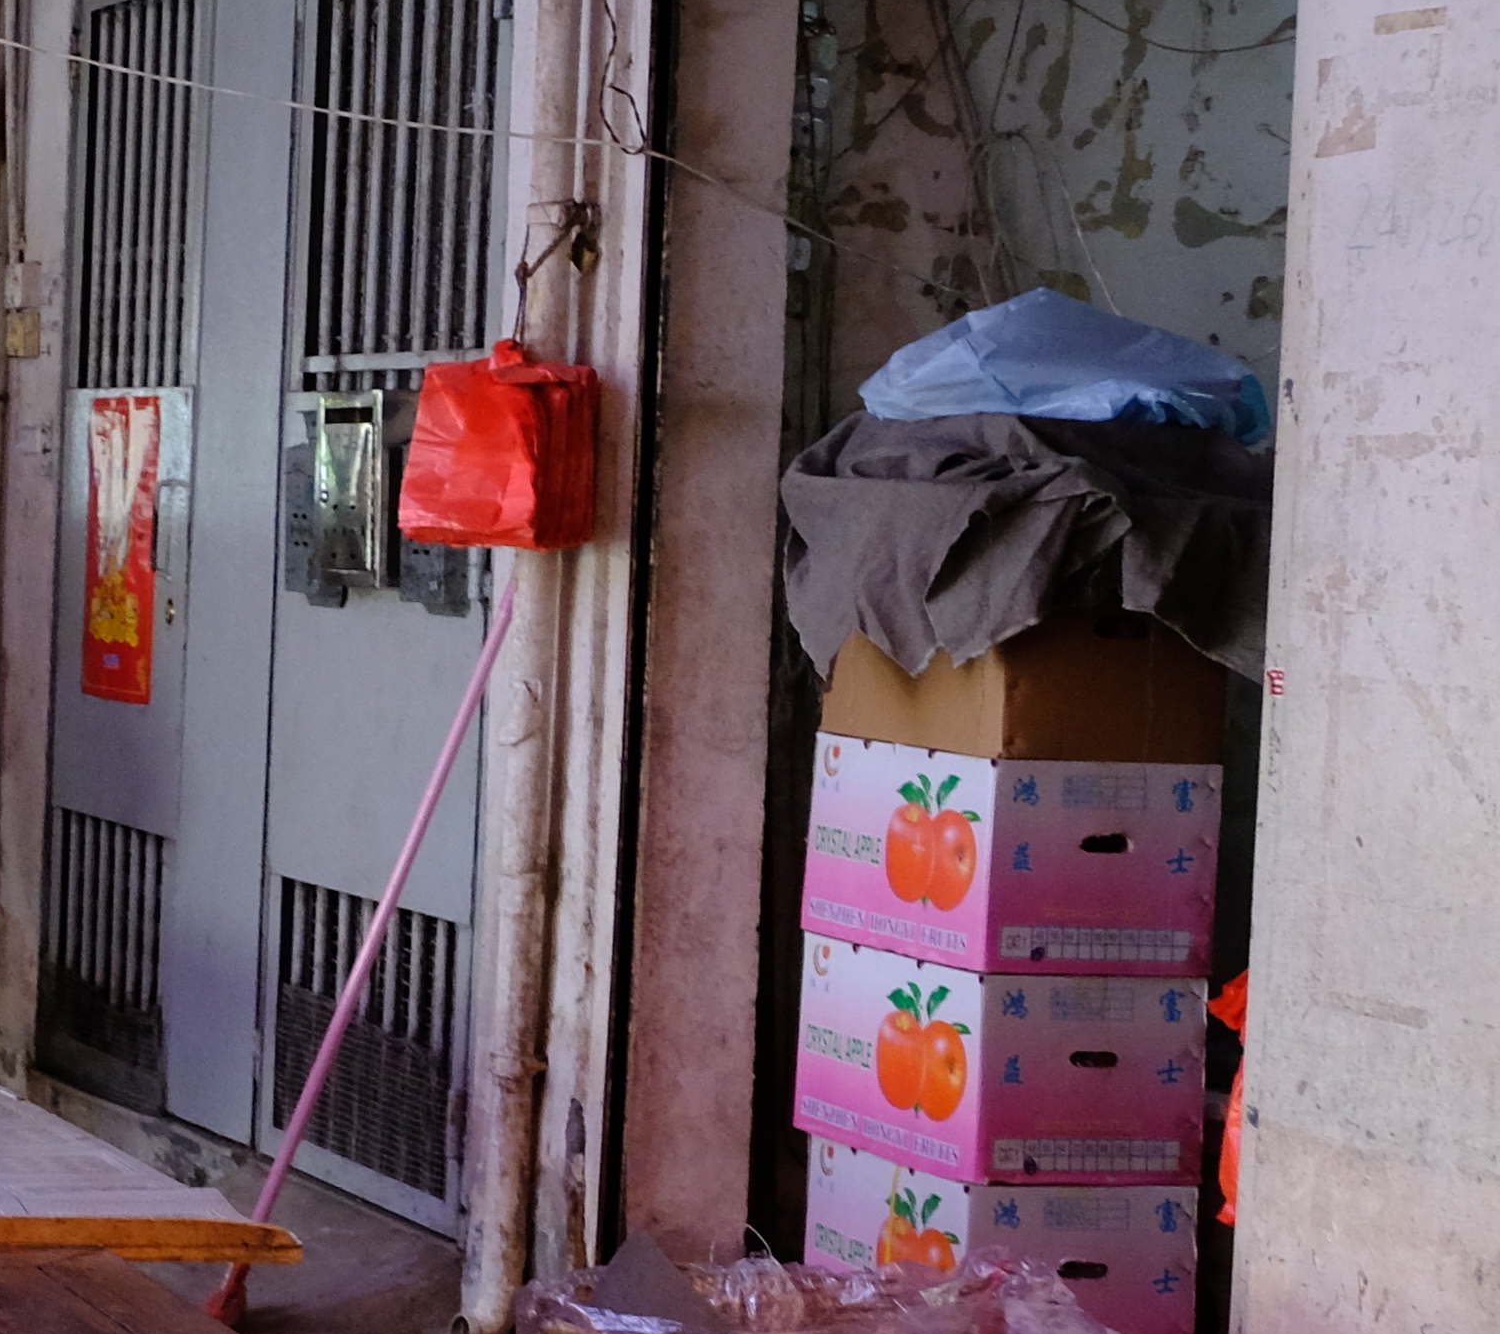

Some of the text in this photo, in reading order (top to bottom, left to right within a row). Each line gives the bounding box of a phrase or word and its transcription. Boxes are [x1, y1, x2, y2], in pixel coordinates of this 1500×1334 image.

[815, 824, 882, 866] CRYSTAL APPLE
[808, 897, 865, 929] SHENZHEN
[920, 924, 968, 954] FRUITS
[806, 1023, 873, 1069] CRYSTAL APPLE
[913, 1130, 960, 1165] FRUITS
